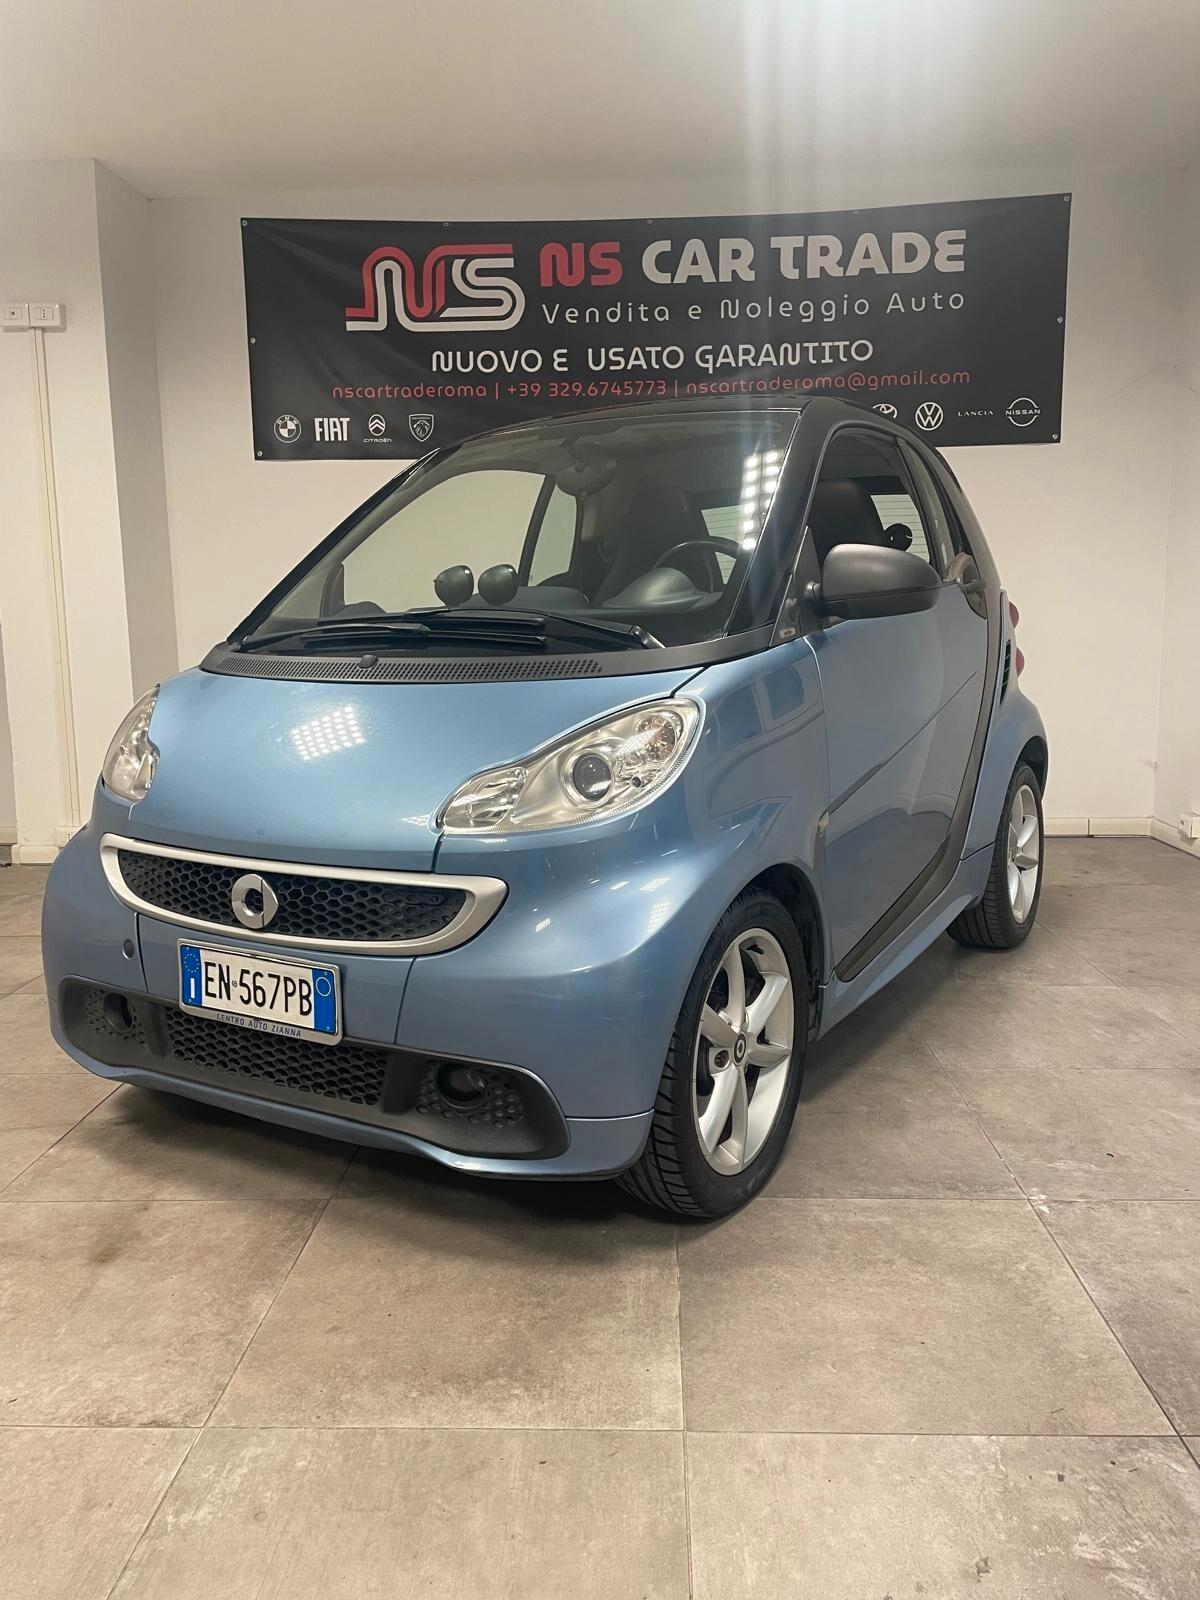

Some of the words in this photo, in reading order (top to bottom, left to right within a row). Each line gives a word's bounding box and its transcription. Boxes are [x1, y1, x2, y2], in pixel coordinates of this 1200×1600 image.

[539, 241, 624, 287] NS
[641, 238, 756, 284] CAR
[770, 229, 967, 281] TRADE
[541, 302, 671, 324] Vendita
[688, 305, 702, 320] e
[720, 295, 870, 323] Noleggio
[886, 292, 965, 315] Auto
[431, 349, 544, 373] NUOVO
[552, 348, 569, 372] E
[587, 345, 685, 371] USATO
[695, 339, 874, 374] GARANTITO
[332, 382, 488, 399] nscartraderoma
[507, 382, 541, 397] +39
[549, 379, 667, 398] 329.6745773
[686, 369, 971, 395] nscartraderoma@gmail.com
[957, 409, 994, 417] LANCIA
[1005, 408, 1041, 416] NISSAN
[314, 417, 350, 442] FIAT
[216, 1013, 245, 1025] CENTRO
[248, 1019, 268, 1031] AUTO
[271, 1024, 301, 1037] ZIANNA
